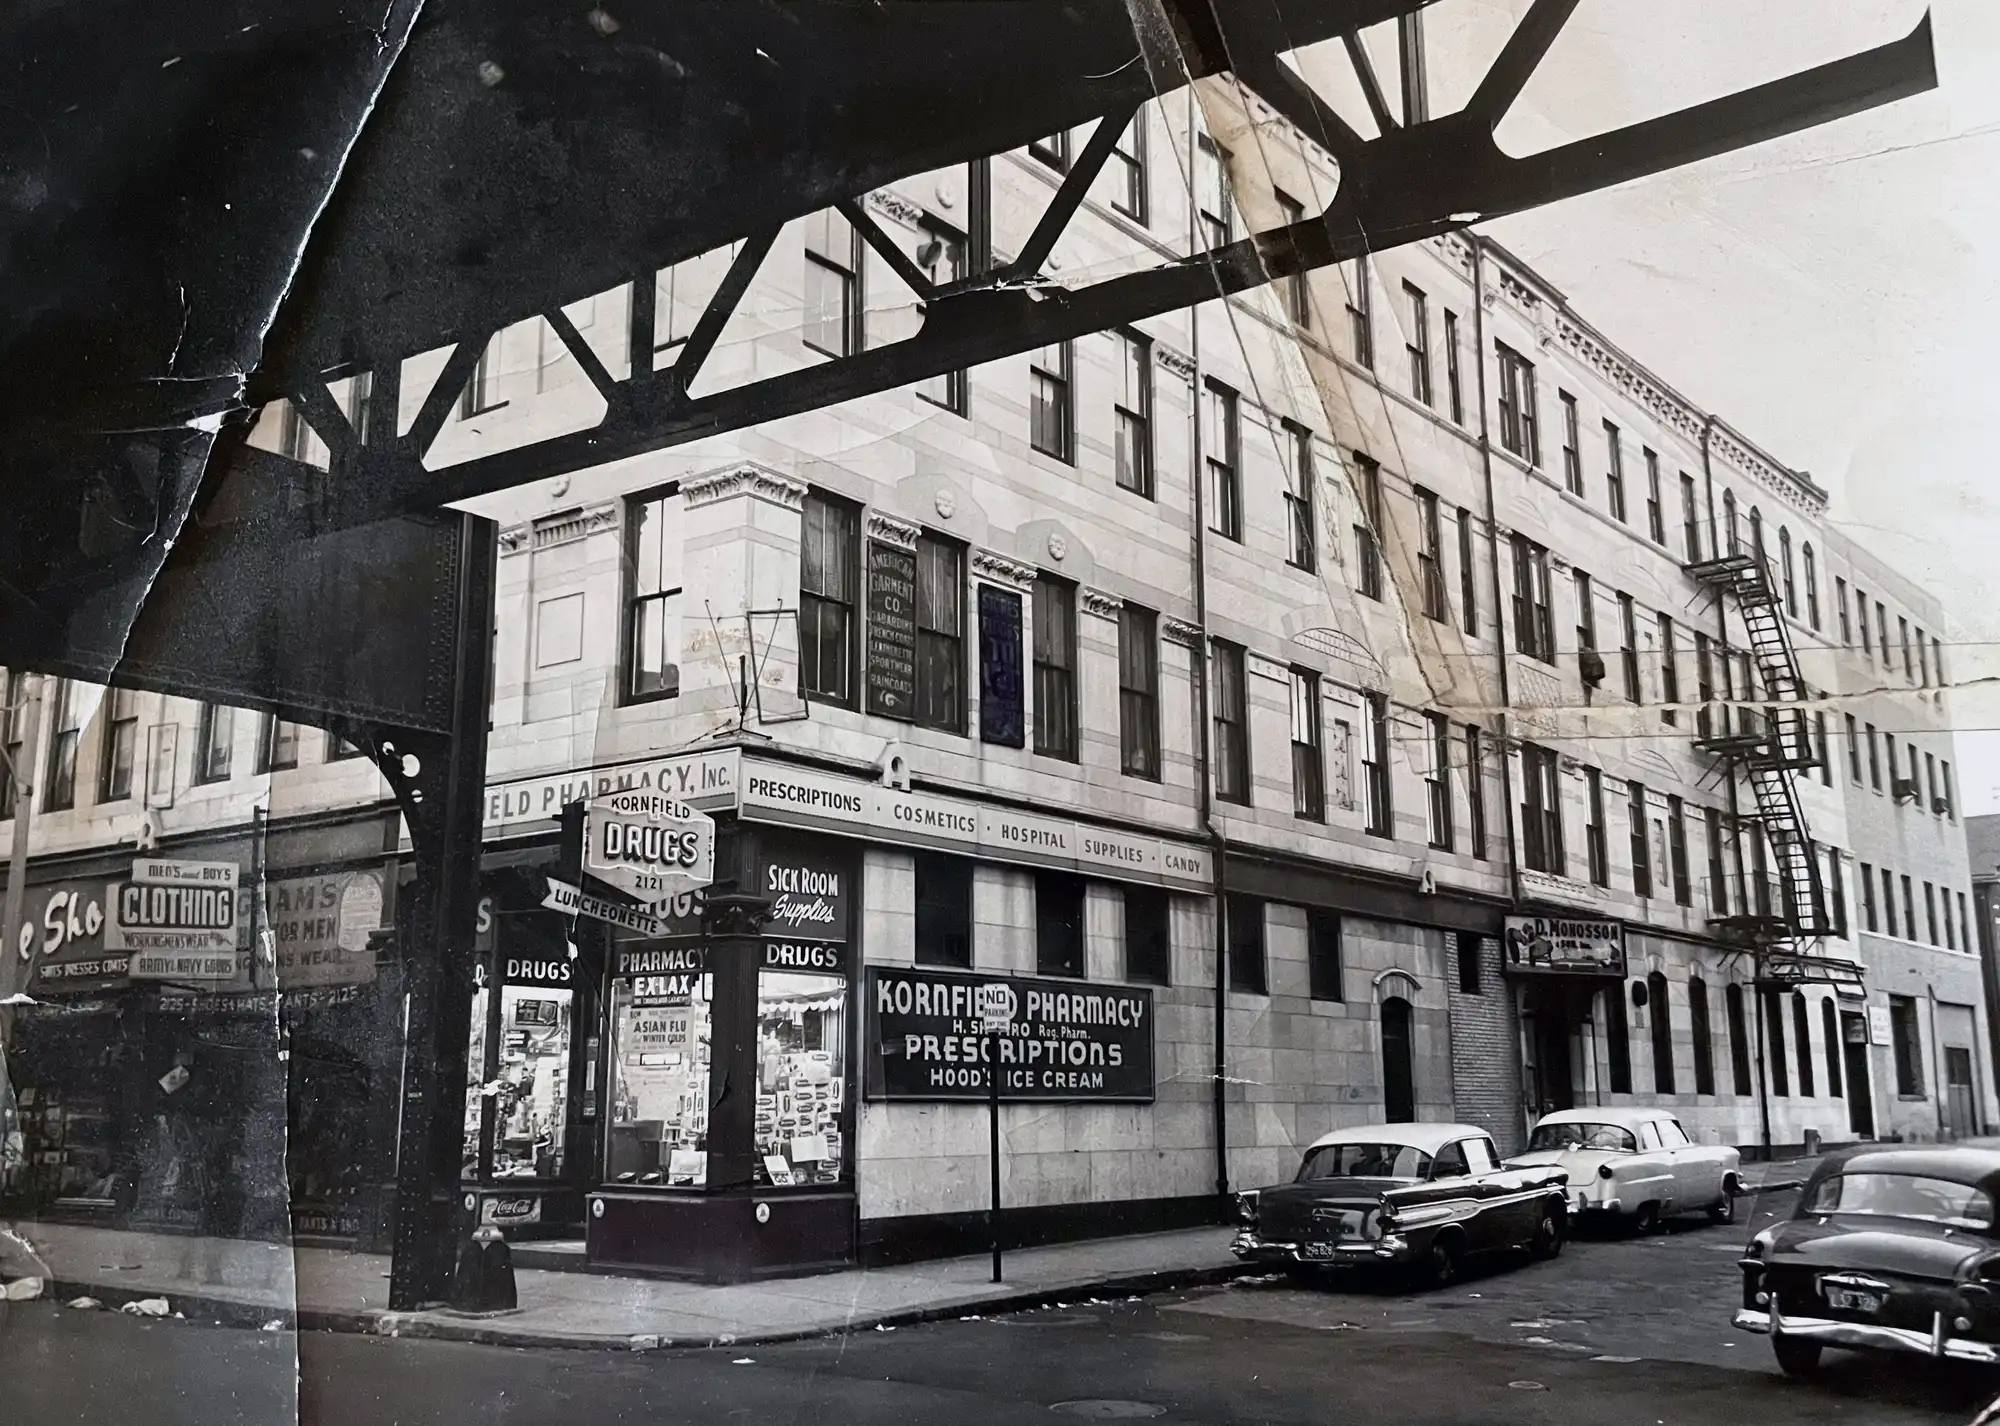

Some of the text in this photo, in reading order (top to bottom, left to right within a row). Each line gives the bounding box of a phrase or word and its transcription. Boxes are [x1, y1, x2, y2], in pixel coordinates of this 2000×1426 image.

[870, 553, 914, 580] AMERICAN
[871, 572, 914, 604] GARMENT
[885, 596, 903, 614] CO.
[871, 674, 913, 694] RAINCOATS
[611, 796, 690, 819] KORNFIELD
[749, 777, 1201, 874] PRESCRIPTIONS COSMETICS HOSPITAL SUPPLIES CANDY
[604, 821, 699, 867] DRUGS
[148, 864, 180, 878] MEN'S
[203, 867, 231, 881] BOY'S
[635, 875, 663, 890] 2121
[768, 864, 838, 896] SICK ROOM
[123, 886, 230, 926] CLOTHING
[554, 888, 658, 934] LUNCHEONETTE
[773, 894, 835, 927] Supplies
[304, 916, 337, 940] MEN
[177, 957, 201, 974] NAVY
[619, 946, 708, 973] PHARMACY
[766, 943, 837, 968] DRUGS
[506, 959, 571, 981] DRUGS
[877, 979, 1143, 1028] KORNFIED PHARMACY
[986, 989, 1006, 1005] NO
[633, 1020, 687, 1033] ASIAN FLU
[952, 1019, 967, 1034] H.
[1039, 1023, 1060, 1041] Reg.
[1061, 1025, 1091, 1040] Pharm.
[1007, 1070, 1035, 1088] ICE
[1042, 1070, 1104, 1088] CREAM
